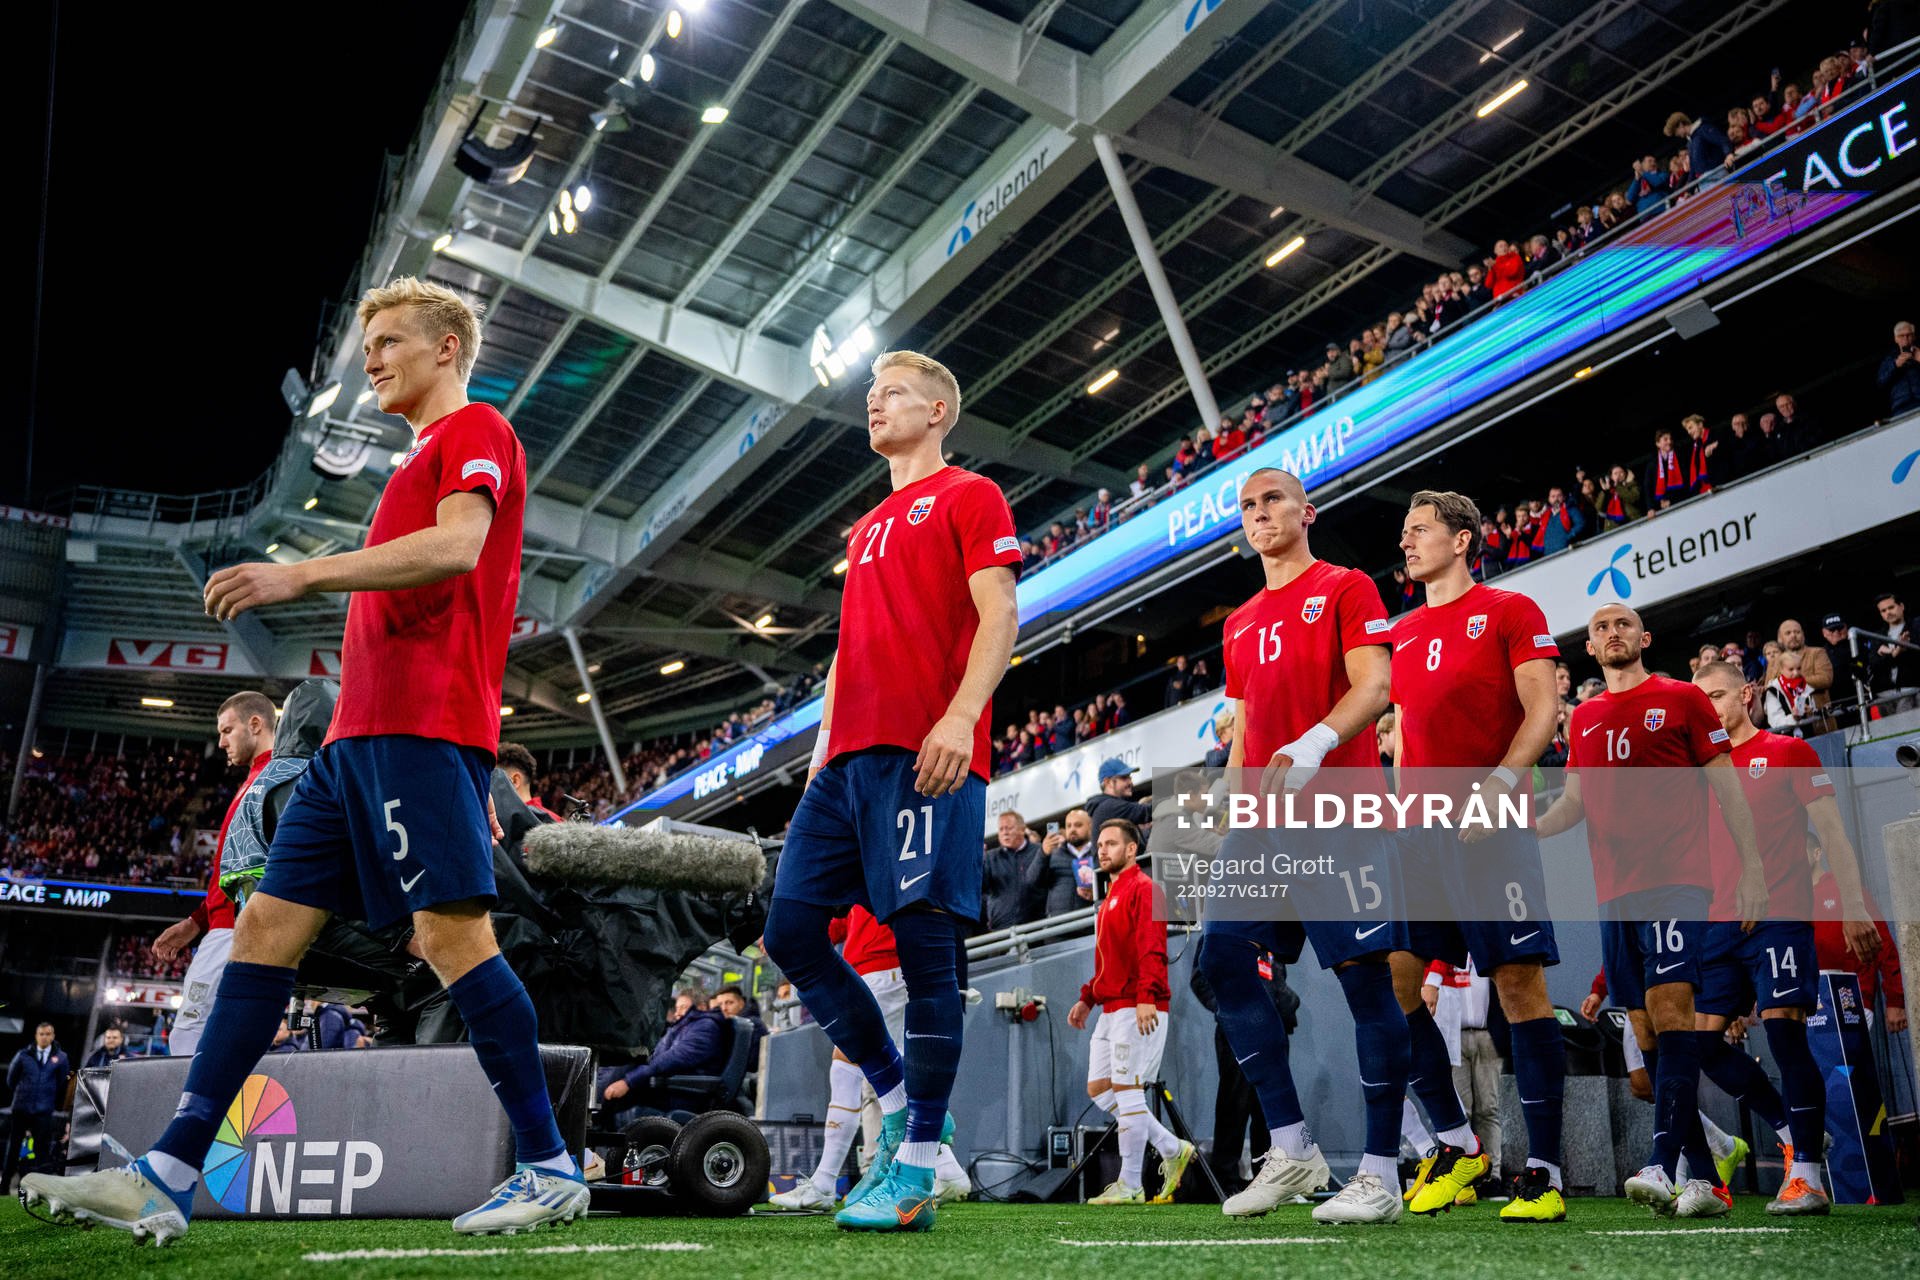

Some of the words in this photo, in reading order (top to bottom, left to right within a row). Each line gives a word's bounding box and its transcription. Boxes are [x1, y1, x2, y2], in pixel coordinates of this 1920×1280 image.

[976, 146, 1049, 230] telenor
[1282, 415, 1354, 477] МИР
[859, 516, 895, 565] 21
[1633, 512, 1757, 580] telenor
[112, 640, 229, 669] VG
[1258, 620, 1284, 665] 15
[1426, 638, 1443, 672] 8
[1606, 727, 1631, 762] 16
[383, 798, 409, 861] 5
[897, 805, 933, 861] 21
[63, 888, 111, 908] МИР
[1339, 864, 1382, 914] 15
[1504, 881, 1528, 922] 8
[1652, 918, 1685, 954] 16
[1766, 946, 1798, 979] 14
[250, 1140, 384, 1214] NEP
